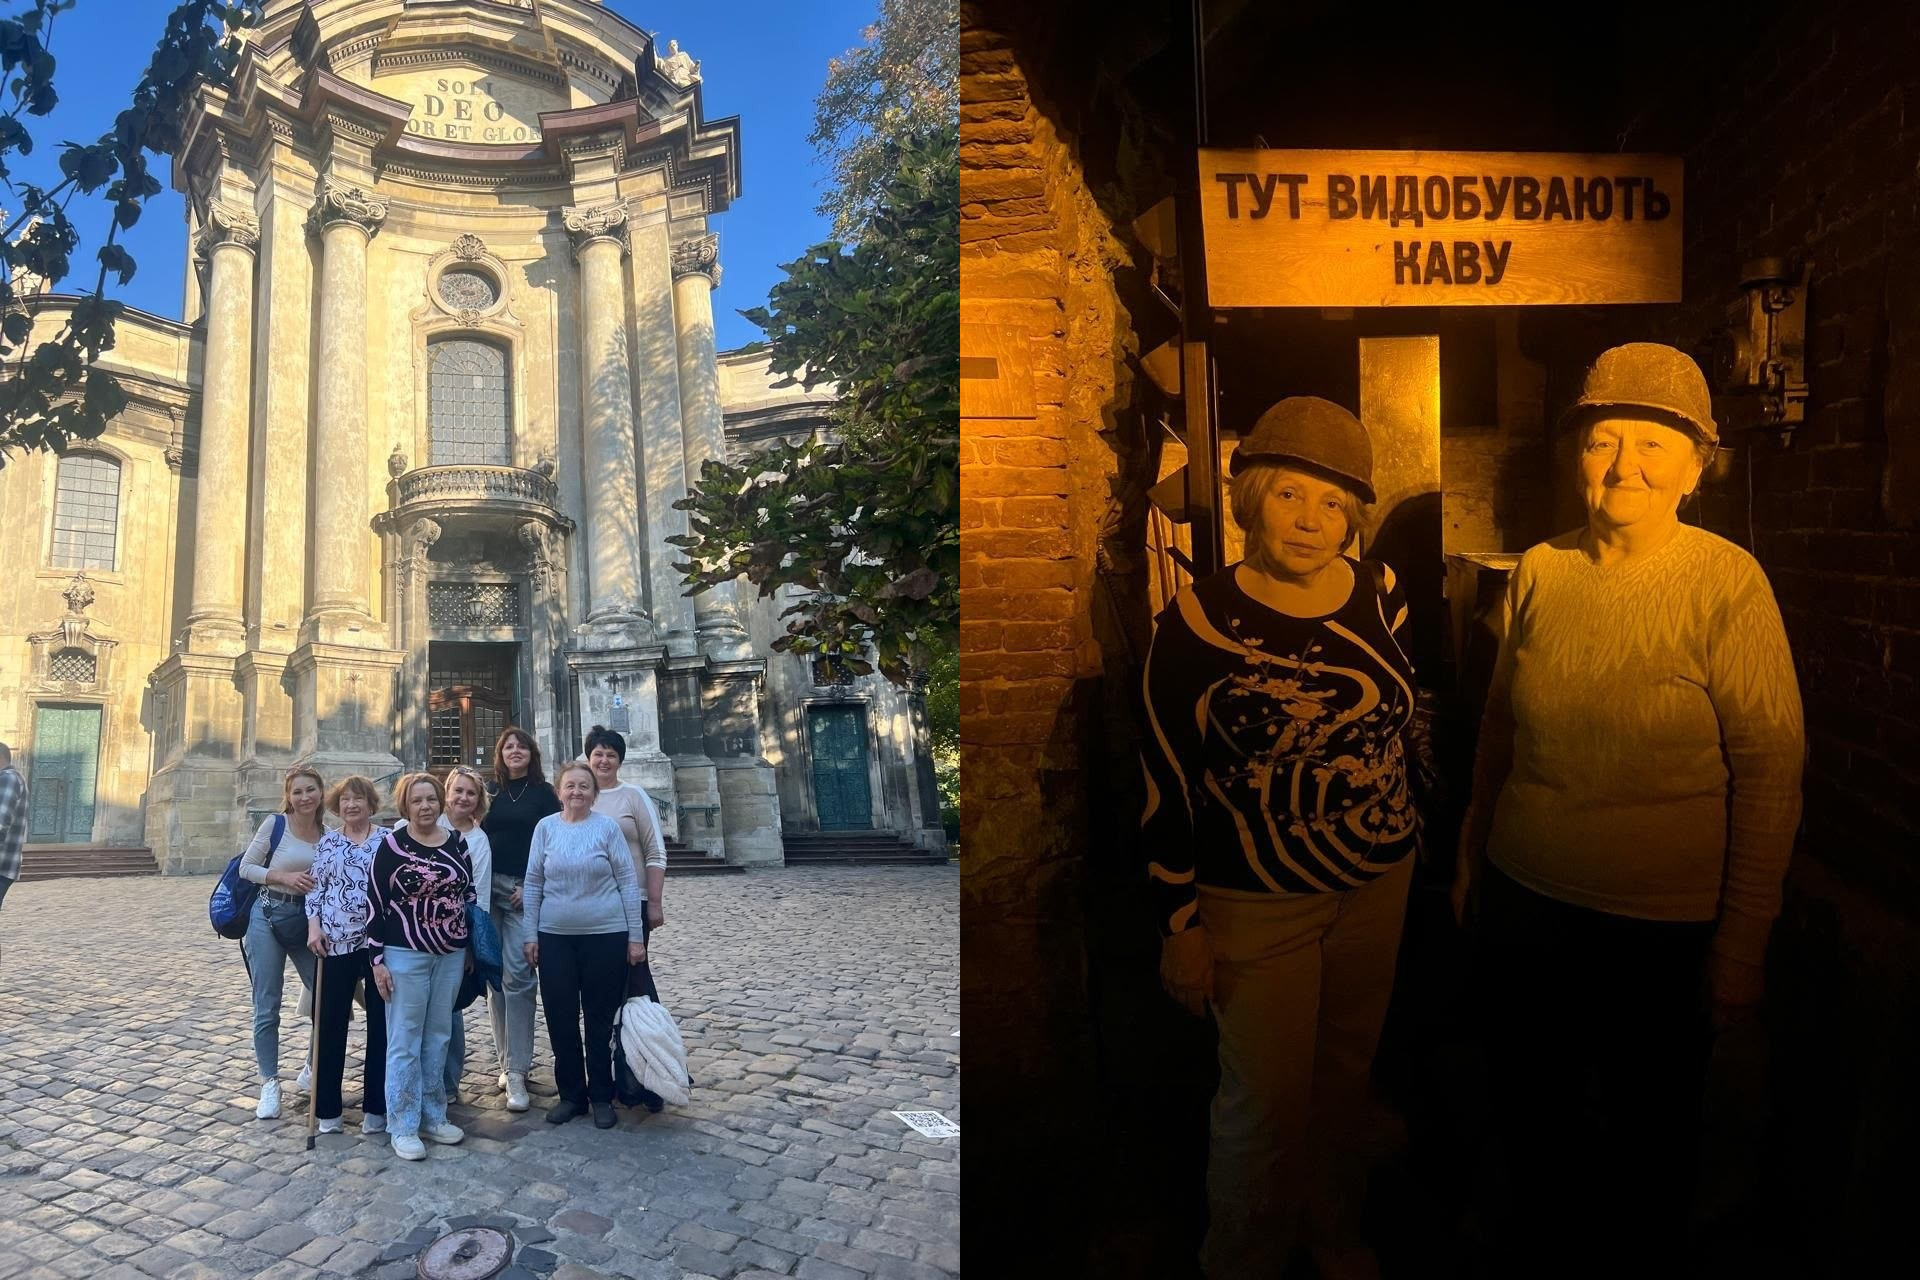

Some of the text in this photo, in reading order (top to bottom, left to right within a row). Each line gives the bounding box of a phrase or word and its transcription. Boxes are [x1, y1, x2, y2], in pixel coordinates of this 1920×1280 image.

[437, 78, 494, 96] SOLI
[424, 94, 504, 121] DEO
[444, 123, 472, 140] ET
[1215, 173, 1671, 228] ТУТ ВИДОБУВАЮТЬ
[1393, 240, 1512, 285] КАВУ
